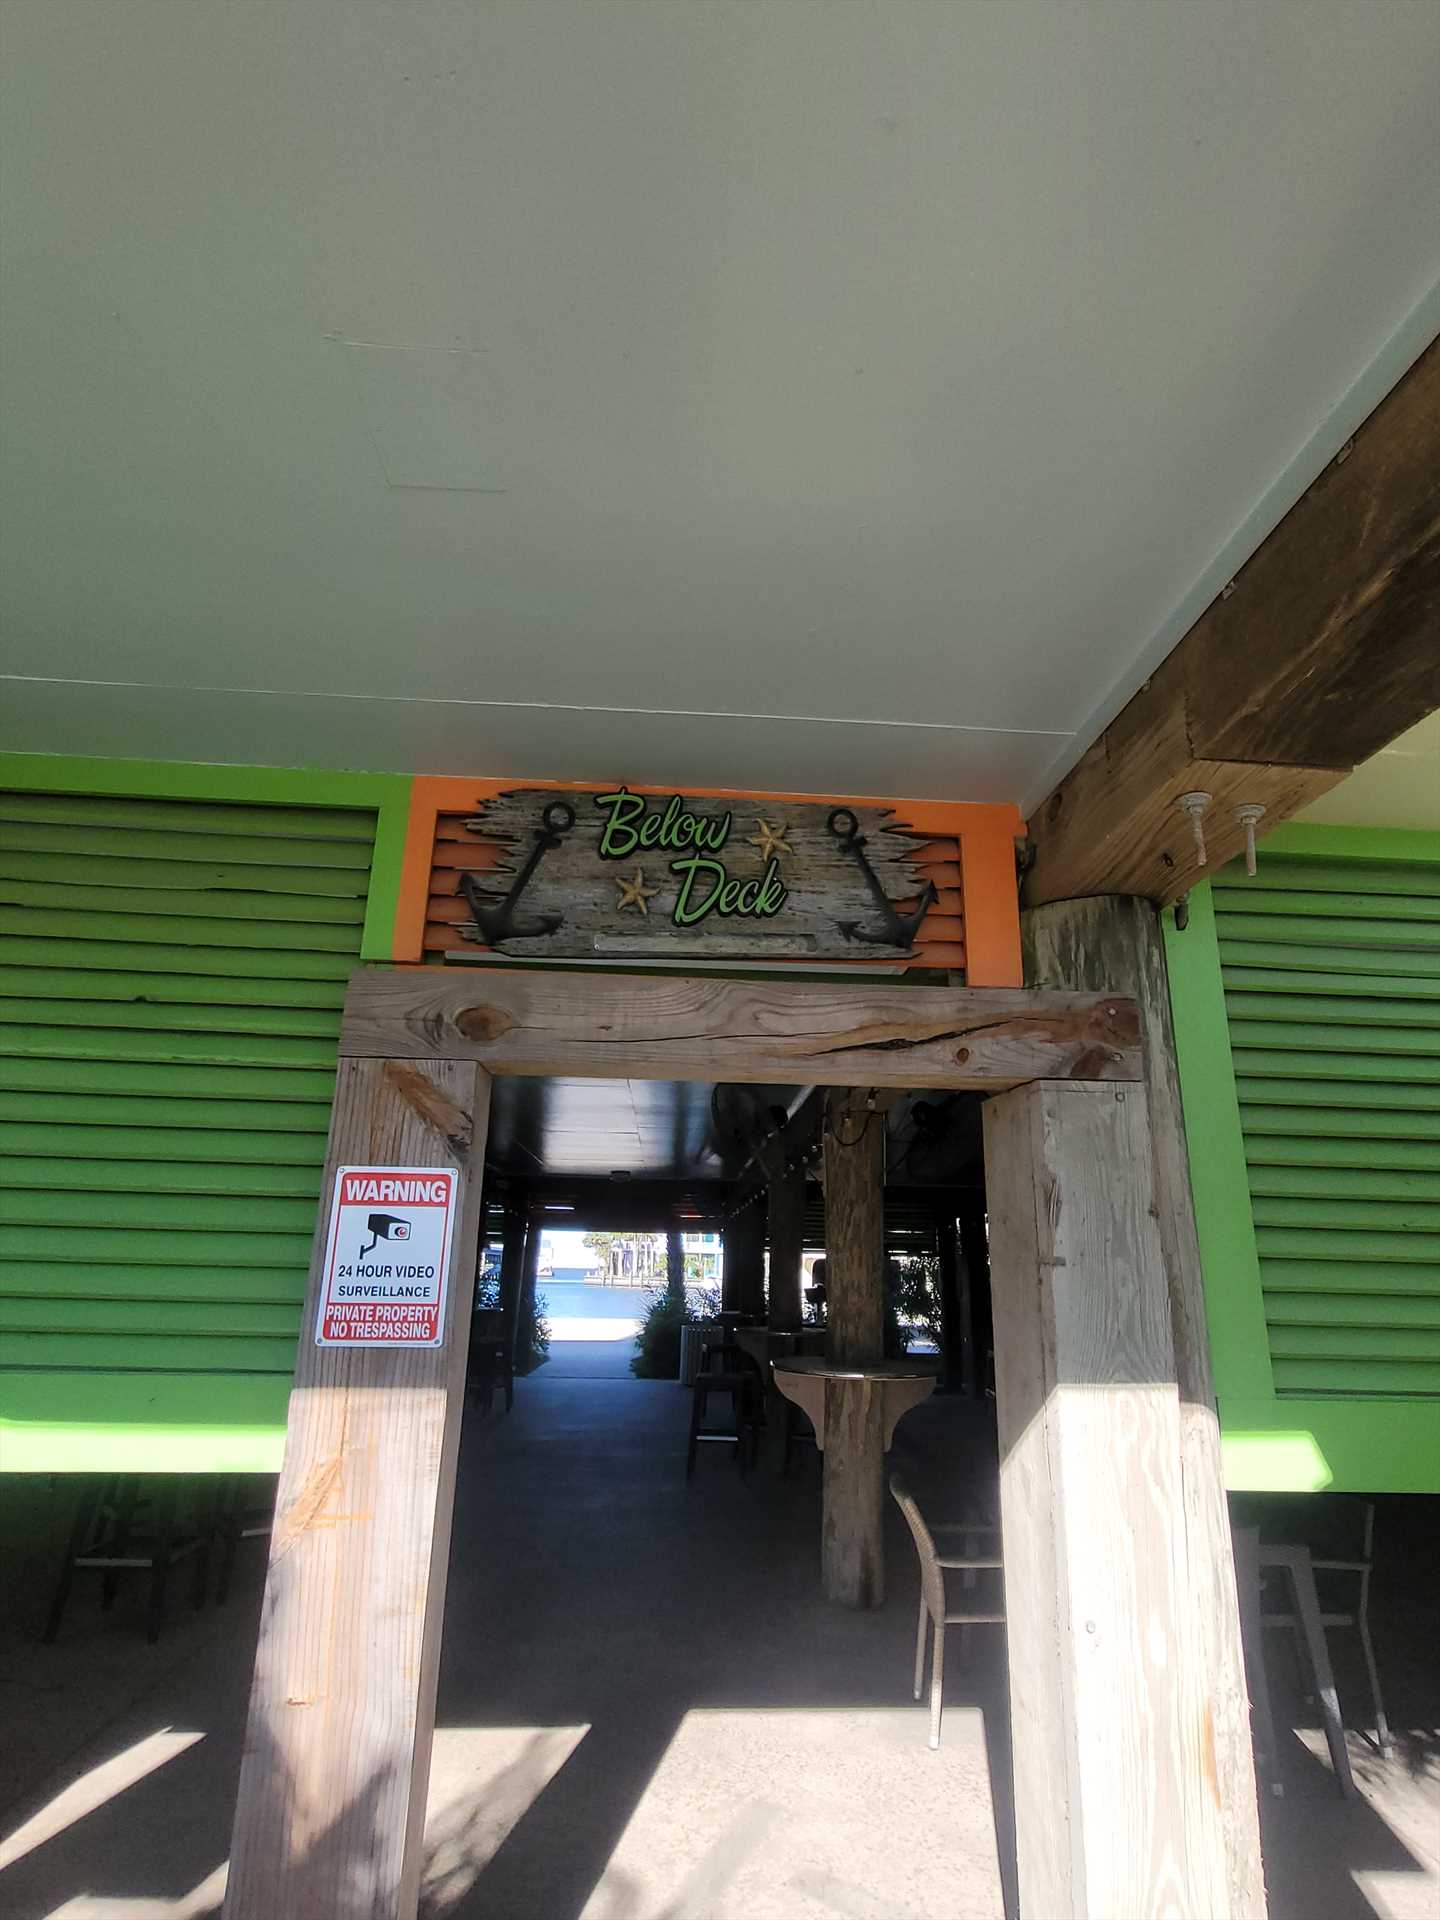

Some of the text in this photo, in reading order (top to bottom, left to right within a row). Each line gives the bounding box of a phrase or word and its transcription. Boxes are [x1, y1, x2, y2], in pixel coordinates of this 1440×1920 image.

[594, 787, 731, 858] Below
[671, 854, 787, 925] Deck
[346, 1180, 447, 1203] WARNING
[338, 1265, 435, 1279] 24 HOUR VIDEO
[338, 1285, 431, 1298] SURVEILLANCE
[326, 1305, 438, 1321] PRIVATE PROPERTY
[330, 1322, 430, 1338] NO TRESPASSING
